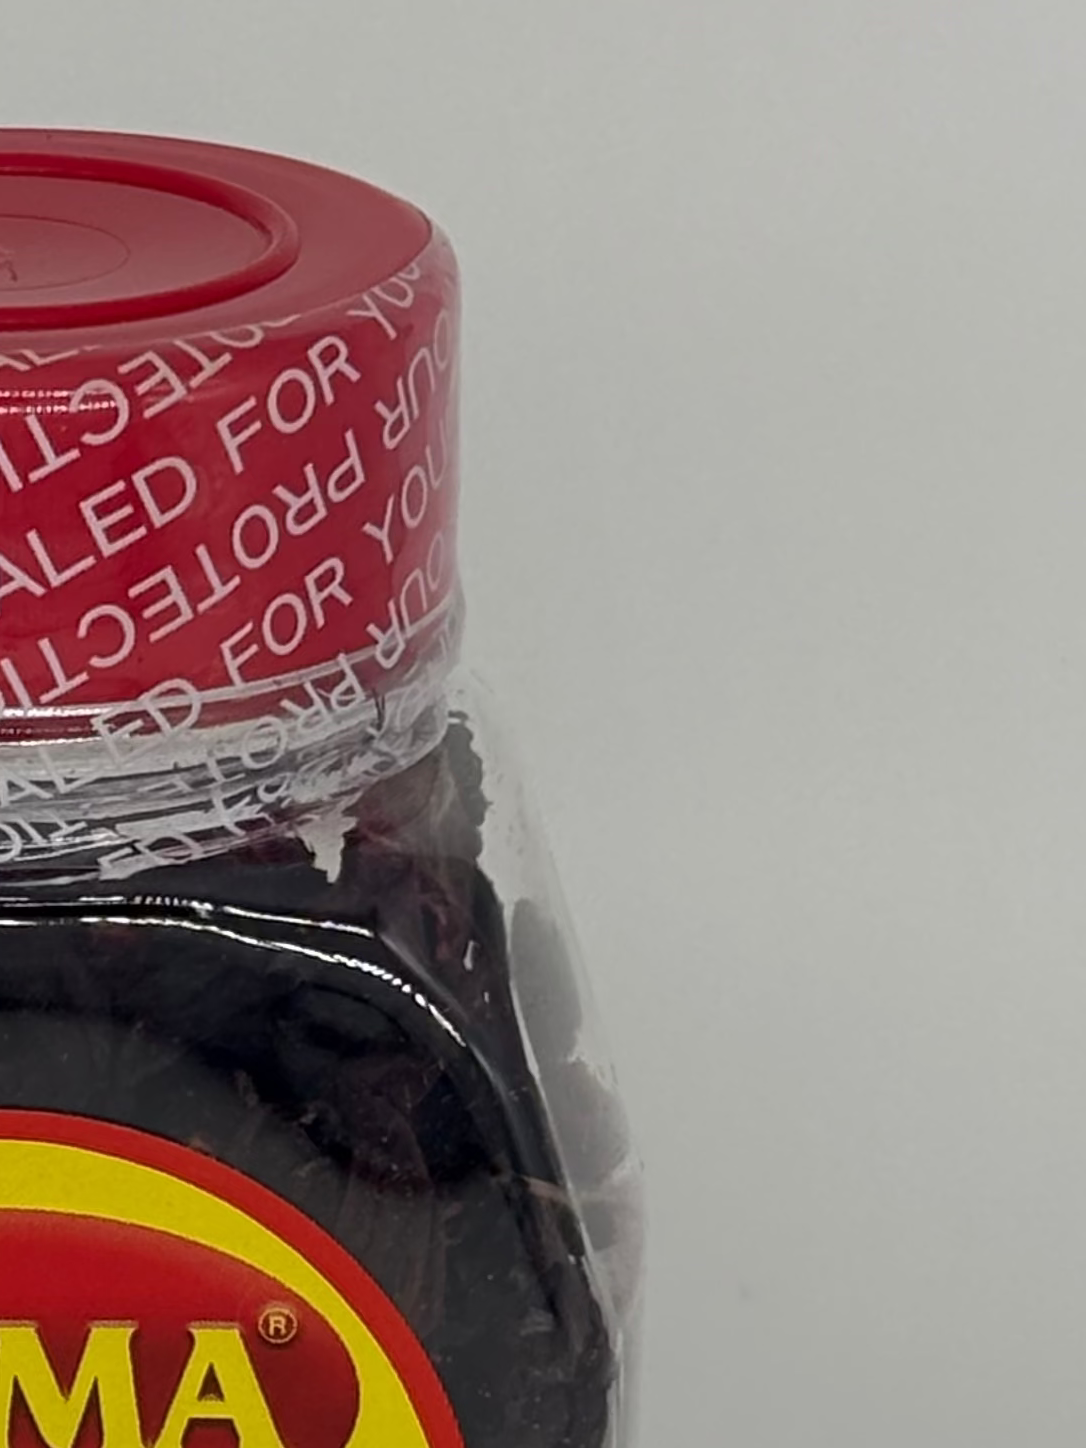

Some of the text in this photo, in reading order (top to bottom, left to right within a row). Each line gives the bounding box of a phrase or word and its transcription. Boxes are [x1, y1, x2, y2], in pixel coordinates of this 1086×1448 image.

[216, 335, 361, 474] FOR
[373, 307, 451, 450] OUR
[220, 556, 354, 687] FOR
[362, 418, 449, 565] YOU
[365, 531, 445, 669] OUR
